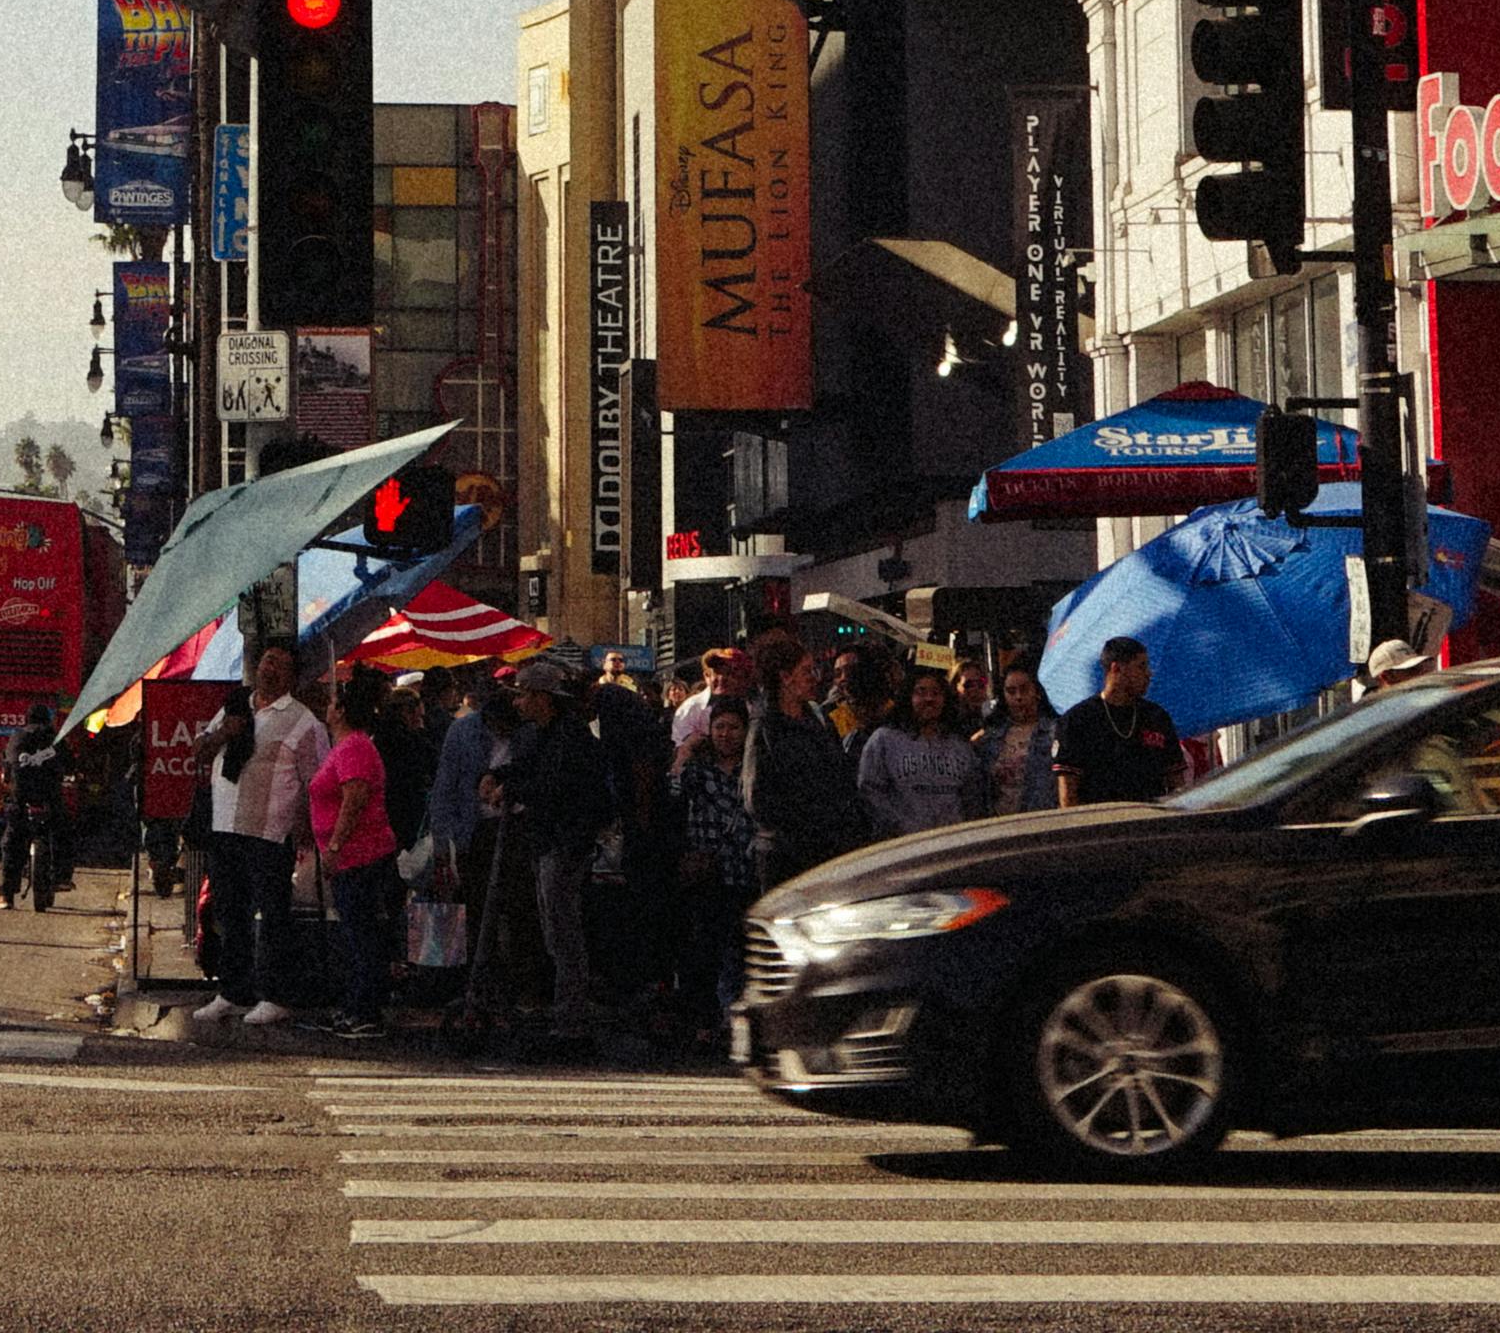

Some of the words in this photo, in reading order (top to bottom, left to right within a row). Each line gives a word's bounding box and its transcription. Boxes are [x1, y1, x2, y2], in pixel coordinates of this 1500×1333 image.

[765, 22, 788, 122] KING
[110, 190, 172, 204] PANTAGES
[217, 133, 229, 209] SIGNAL
[697, 29, 758, 340] MUFASA
[769, 147, 791, 241] LION
[1026, 115, 1042, 233] PLAYER
[1052, 174, 1066, 282] VIRTUAL
[596, 223, 623, 376] THEATRE
[767, 267, 792, 339] THE
[1026, 243, 1044, 302] ONE
[228, 335, 276, 351] DIAGONAL
[228, 350, 278, 366] CROSSING
[1029, 312, 1044, 352] VR
[1054, 290, 1068, 397] REALITY
[1105, 445, 1200, 457] TOURS
[12, 577, 35, 591] Hop
